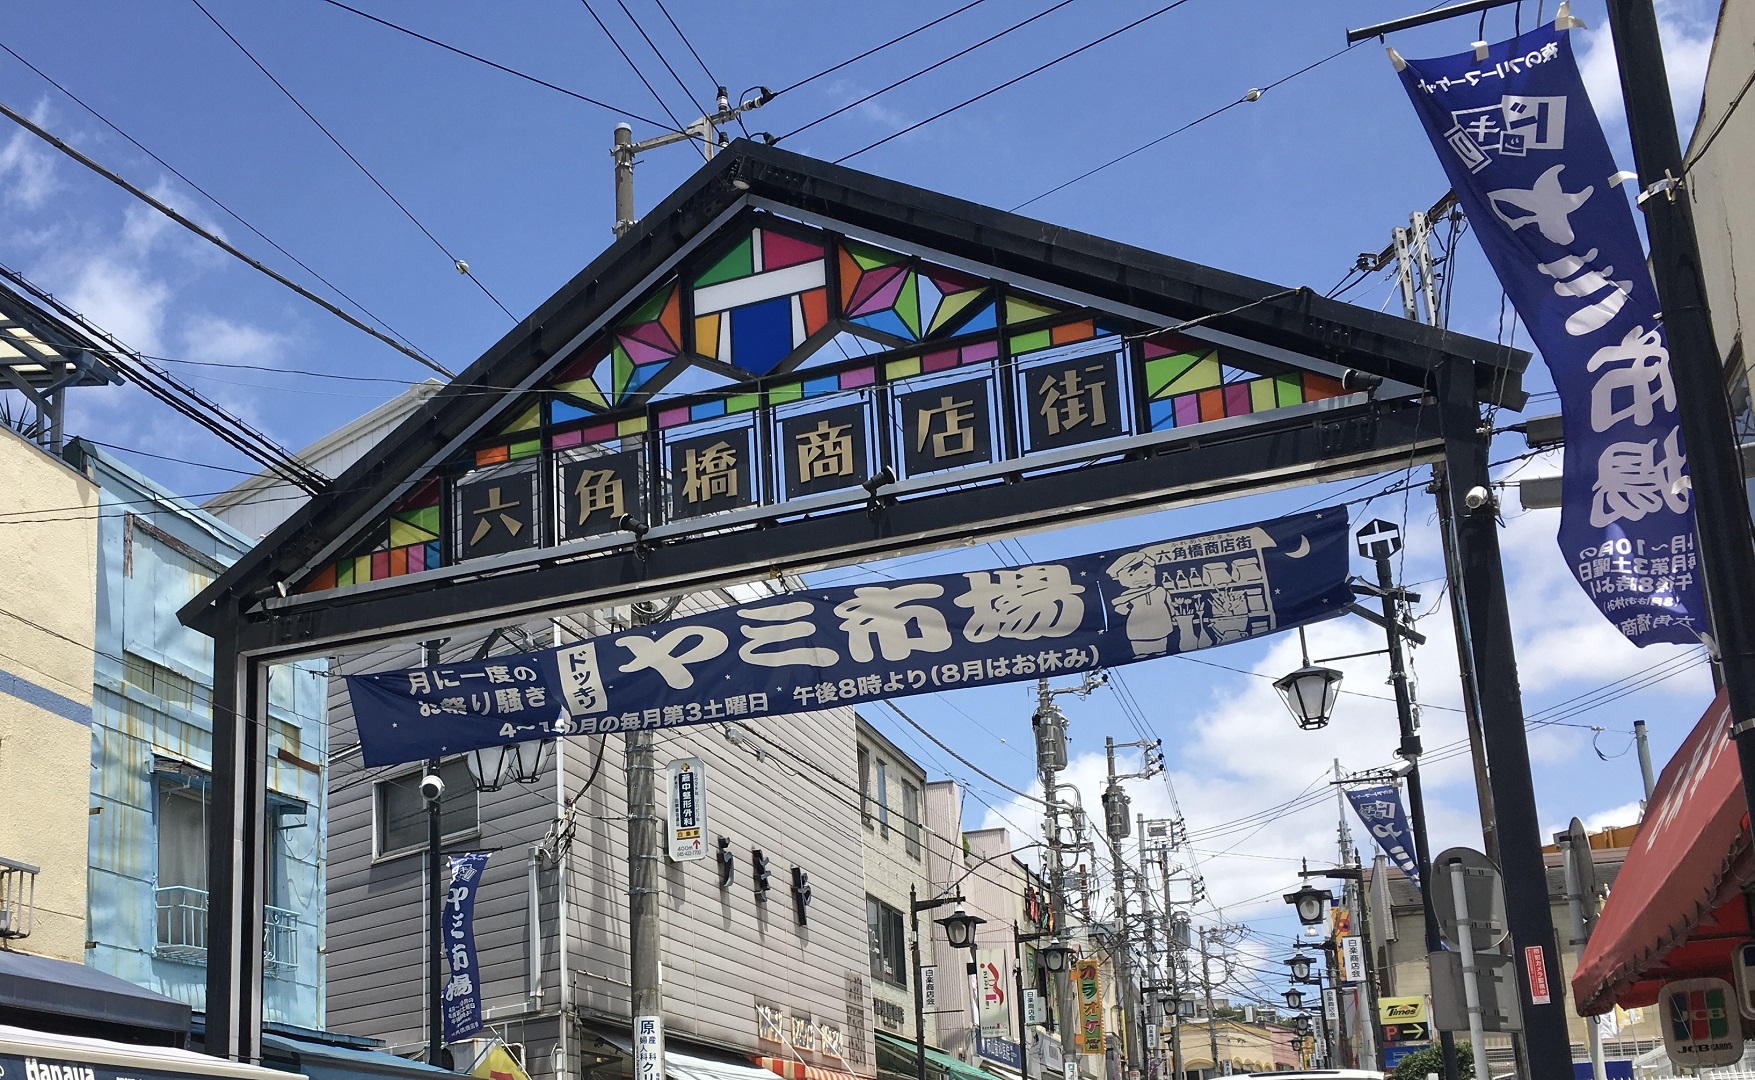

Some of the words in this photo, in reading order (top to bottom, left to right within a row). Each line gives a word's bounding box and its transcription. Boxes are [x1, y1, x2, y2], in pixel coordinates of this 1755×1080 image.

[471, 364, 1108, 546] 六角橋商店街
[1156, 535, 1252, 563] 六角橋商店街
[408, 666, 537, 696] 月に一度の
[568, 650, 597, 710] ドッキリ
[418, 686, 546, 716] お祭り騒ぎ
[1348, 939, 1362, 978] 白楽商店会
[925, 969, 935, 1006] 白楽商店会
[1080, 964, 1099, 1034] カラオケ
[1386, 1003, 1419, 1017] Times
[1673, 1007, 1726, 1022] JCB
[641, 1021, 655, 1035] 原
[1386, 1025, 1398, 1041] P
[1677, 1044, 1711, 1054] JCB
